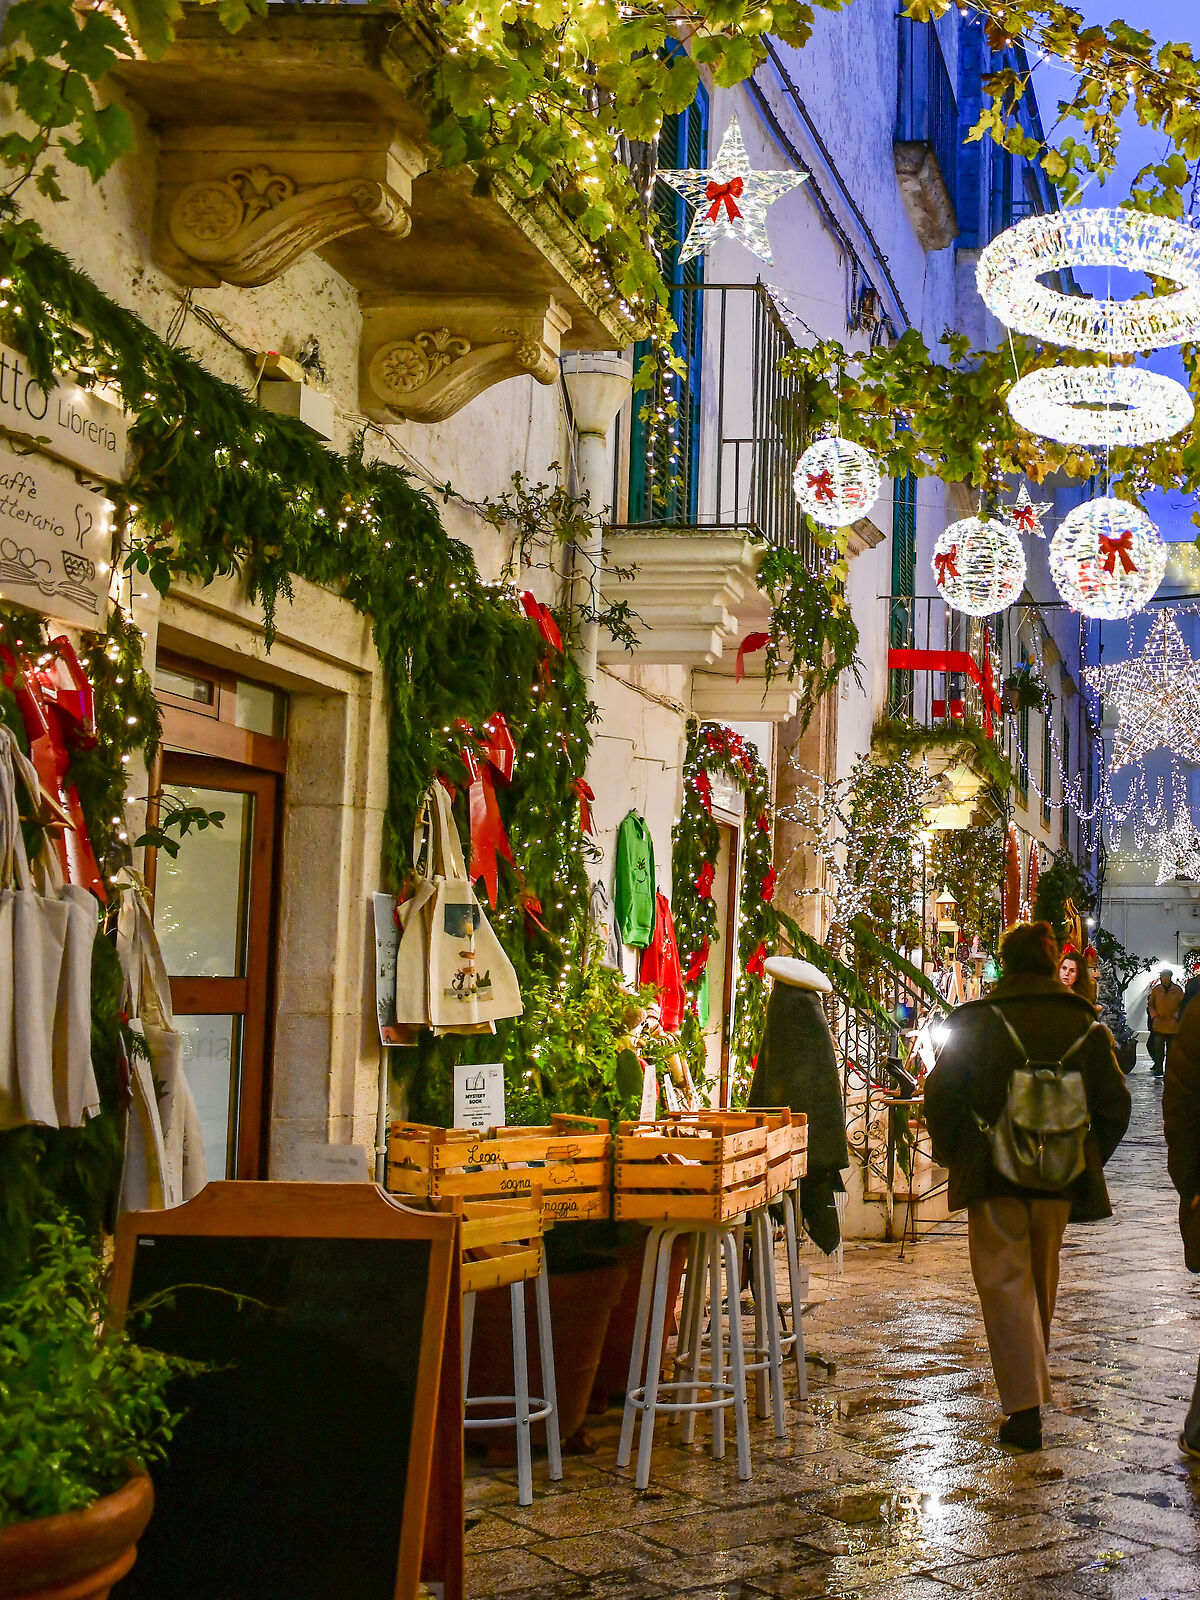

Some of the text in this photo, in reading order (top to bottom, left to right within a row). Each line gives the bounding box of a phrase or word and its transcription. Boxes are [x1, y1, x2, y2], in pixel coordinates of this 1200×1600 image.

[58, 399, 116, 453] Libreria
[0, 471, 37, 499] affè
[0, 495, 64, 537] tterario
[500, 1179, 532, 1191] sogna
